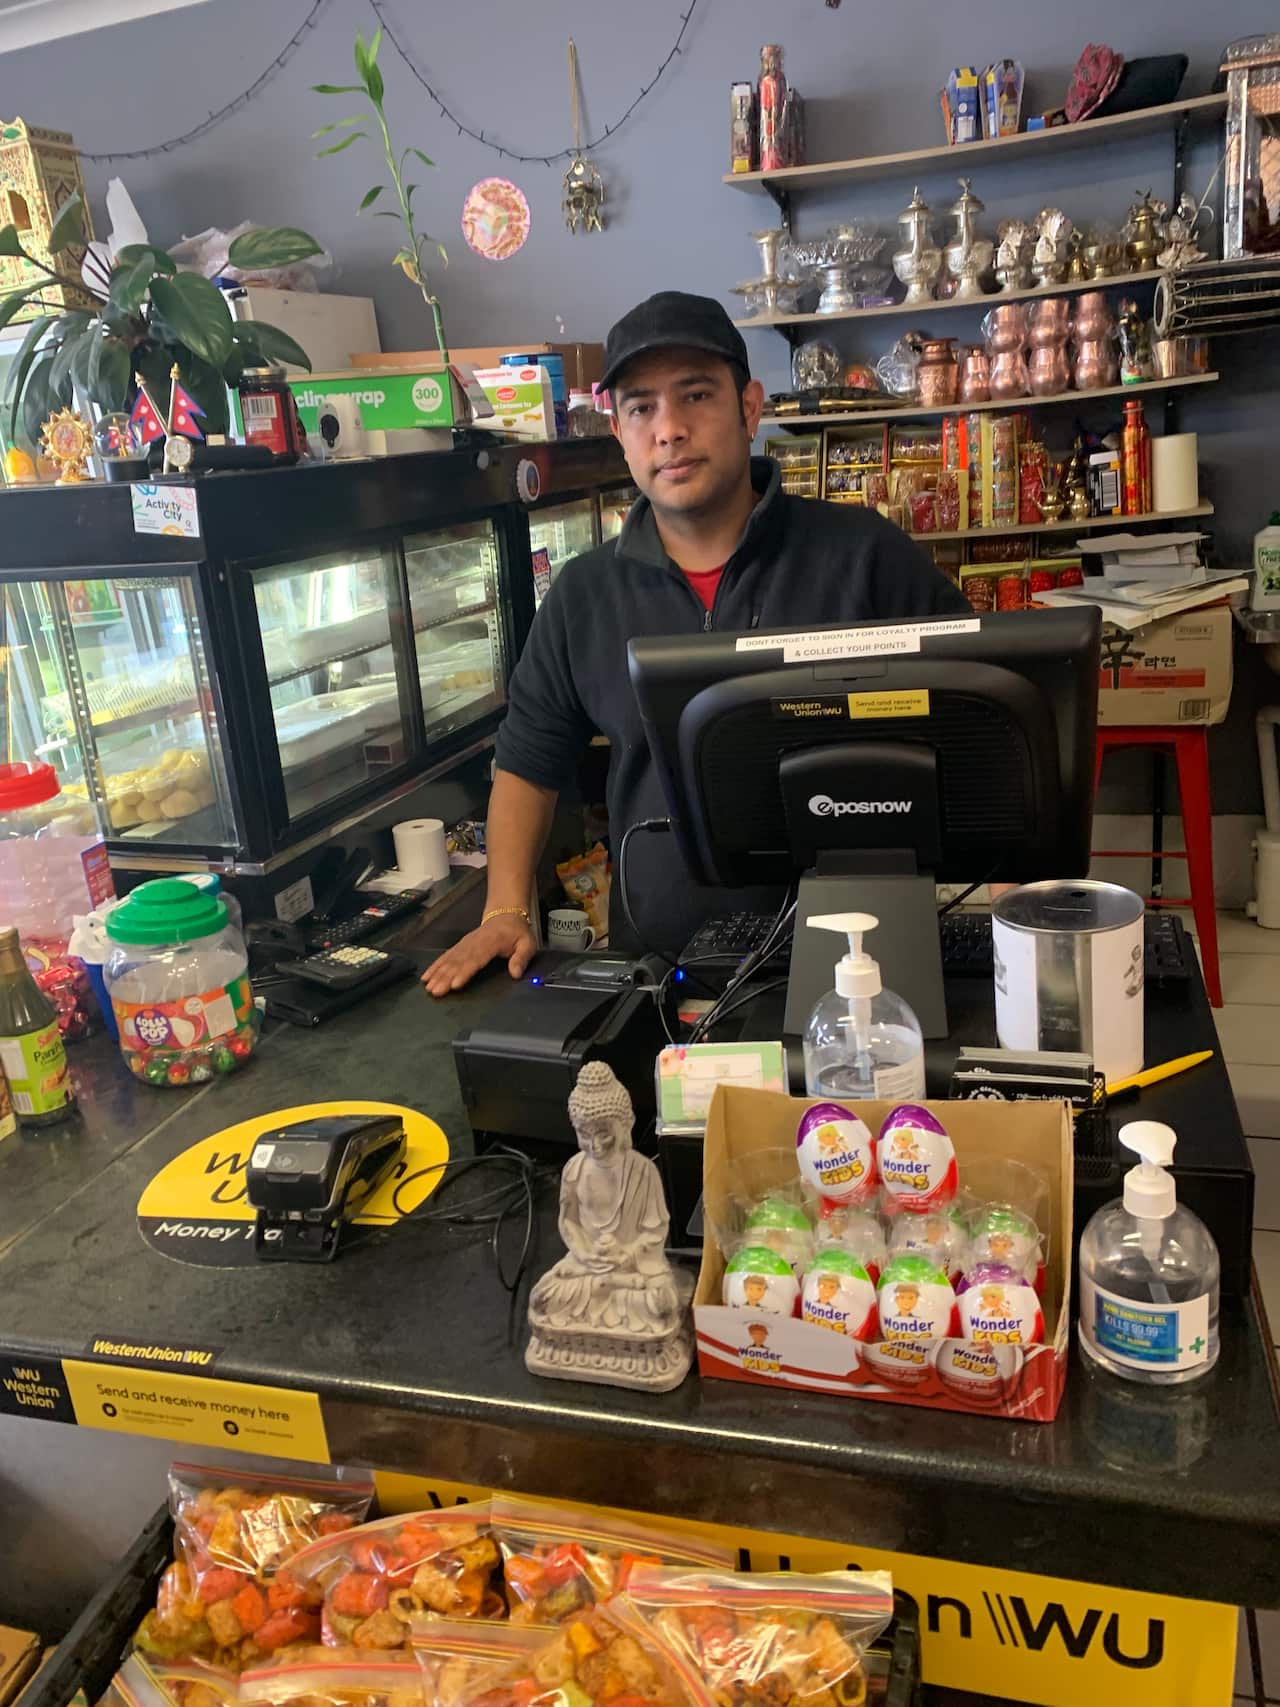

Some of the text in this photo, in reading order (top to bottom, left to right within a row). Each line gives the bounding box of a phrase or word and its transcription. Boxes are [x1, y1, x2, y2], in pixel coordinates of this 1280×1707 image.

[416, 388, 438, 399] 300
[163, 510, 182, 521] City
[771, 637, 805, 645] FORGET
[876, 627, 918, 636] LOYALTY
[919, 623, 967, 633] PROGRAM
[803, 646, 844, 656] COLLECT
[846, 644, 871, 653] YOUR
[874, 641, 907, 650] POINTS
[779, 702, 822, 711] Western
[794, 707, 842, 717] Union WU
[139, 1026, 169, 1038] POP
[813, 1148, 860, 1171] Wonder
[882, 1159, 932, 1174] Wonder
[819, 1160, 864, 1185] KIDS
[884, 1172, 929, 1190] KIDS
[154, 1222, 239, 1243] Money
[804, 1300, 851, 1321] Wonder
[884, 1316, 934, 1332] Wonder
[970, 1316, 1023, 1331] Wonder
[186, 1351, 212, 1365] WU
[739, 1347, 783, 1361] Wonder
[880, 1344, 925, 1364] KIDS
[742, 1358, 781, 1373] KIDS
[952, 1356, 997, 1377] KIDS
[16, 1368, 40, 1382] WU
[4, 1380, 60, 1398] Western
[16, 1392, 54, 1408] Union
[96, 1384, 128, 1399] Send
[132, 1391, 157, 1403] and
[160, 1395, 207, 1410] receive
[210, 1402, 255, 1419] money
[258, 1406, 290, 1422] here
